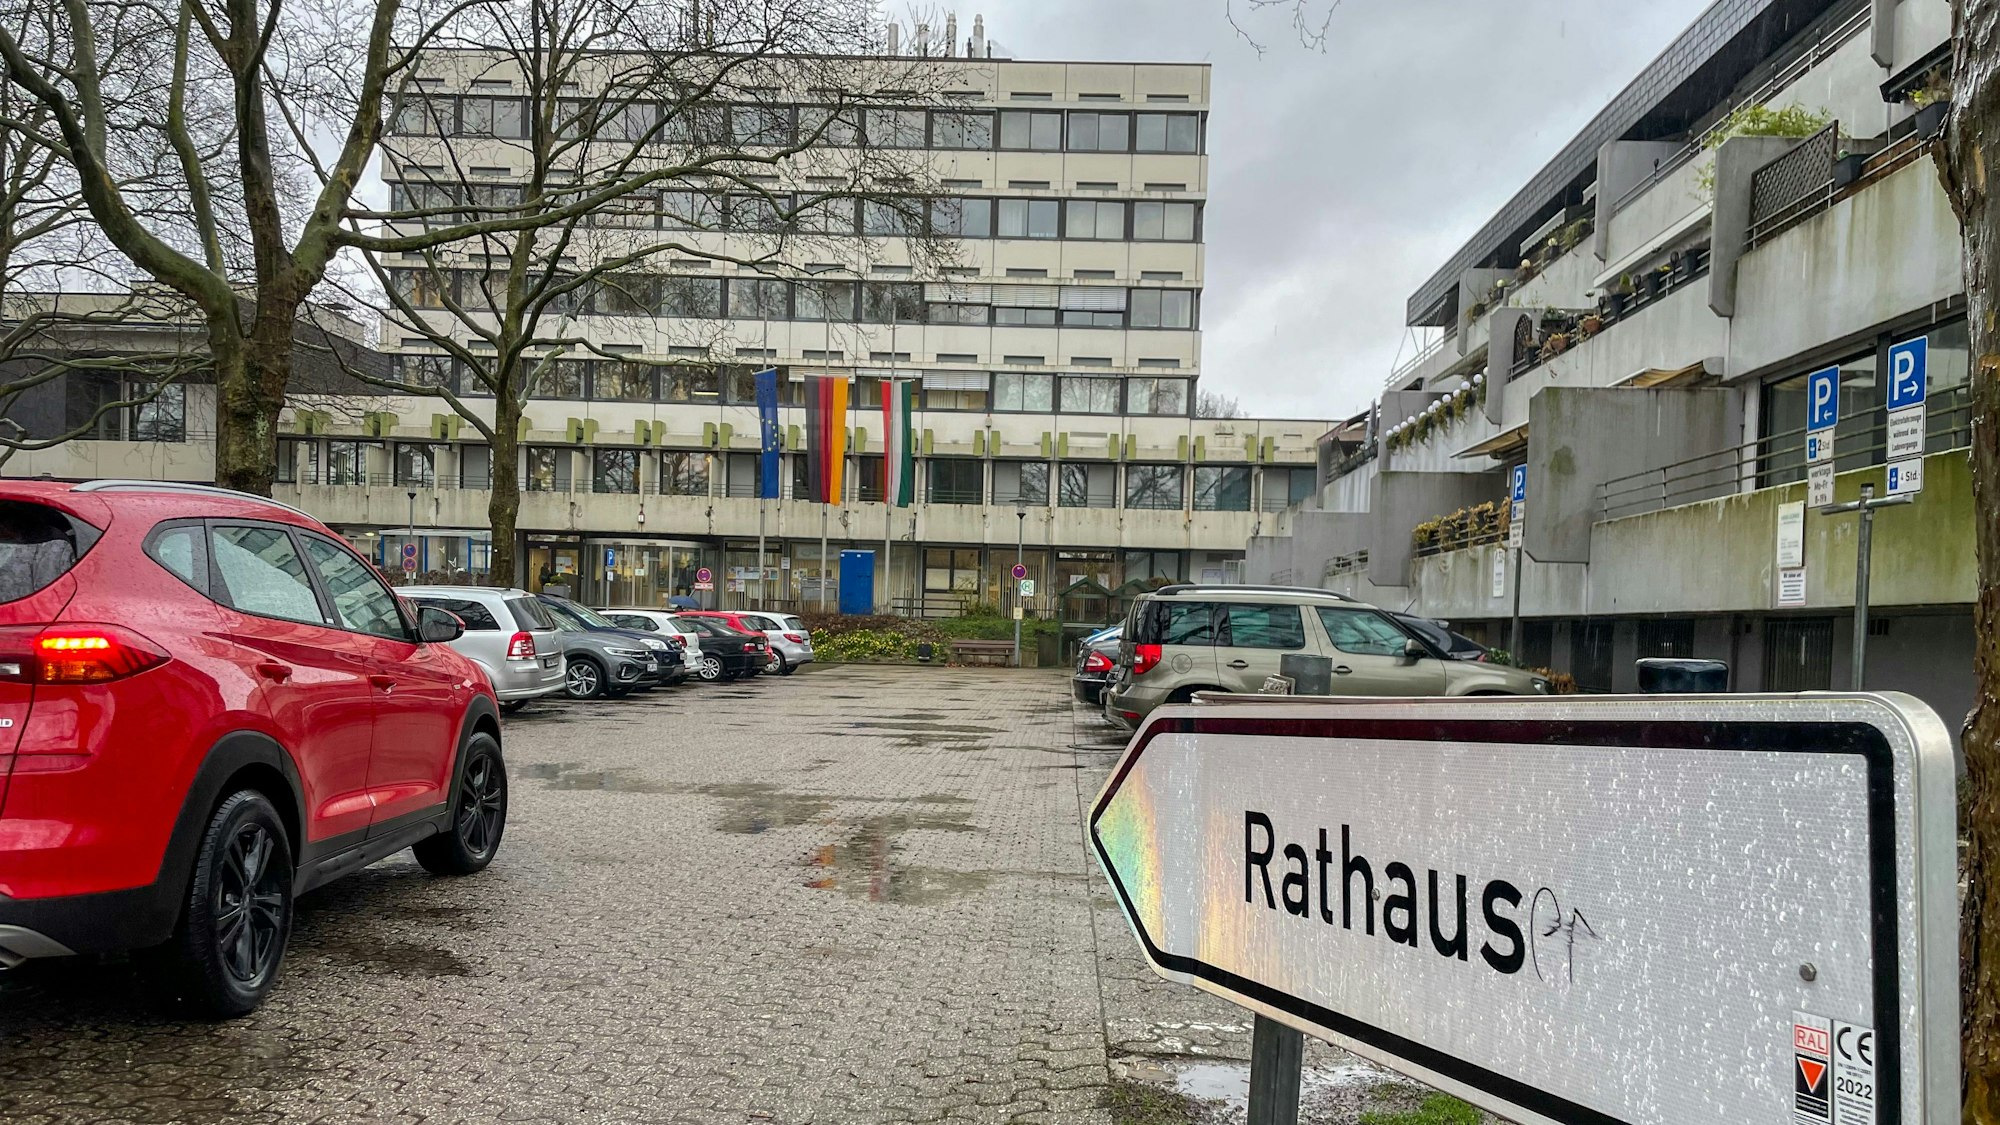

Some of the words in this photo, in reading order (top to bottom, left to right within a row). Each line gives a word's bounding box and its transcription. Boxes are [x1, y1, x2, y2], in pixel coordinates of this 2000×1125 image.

[1893, 350, 1915, 401] P
[1814, 377, 1832, 423] P
[1817, 439, 1822, 451] 2
[1514, 470, 1523, 498] P
[1245, 810, 1526, 975] Rathaus
[1797, 1029, 1825, 1051] RAL
[1836, 1026, 1873, 1067] CE
[1836, 1076, 1873, 1100] 2022
